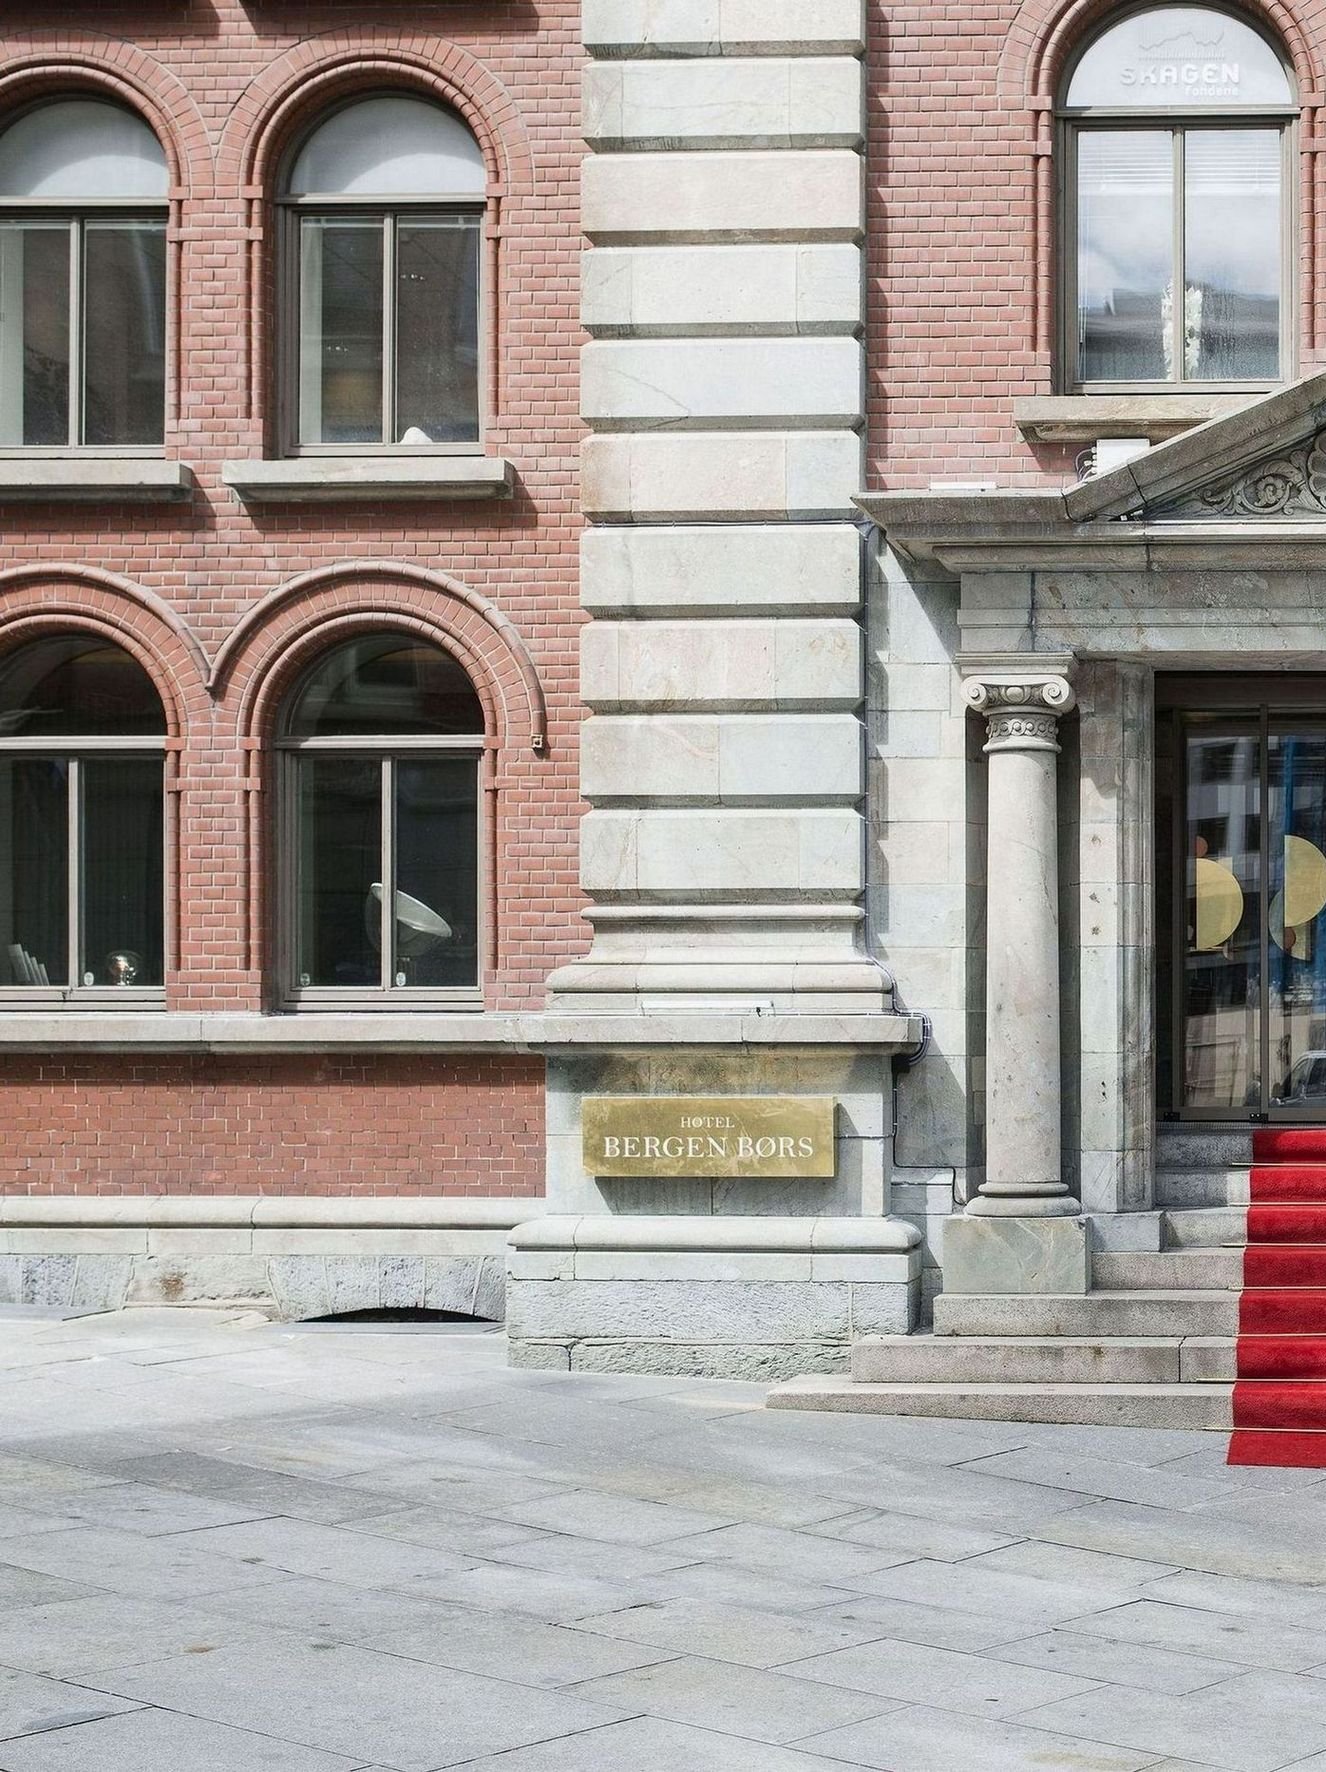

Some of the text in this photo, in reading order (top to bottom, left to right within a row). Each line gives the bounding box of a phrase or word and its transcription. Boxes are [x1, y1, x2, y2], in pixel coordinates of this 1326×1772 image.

[1120, 63, 1241, 86] SKAGEN
[680, 1116, 735, 1129] HOTEL
[603, 1135, 814, 1158] BERGEN BØRS
